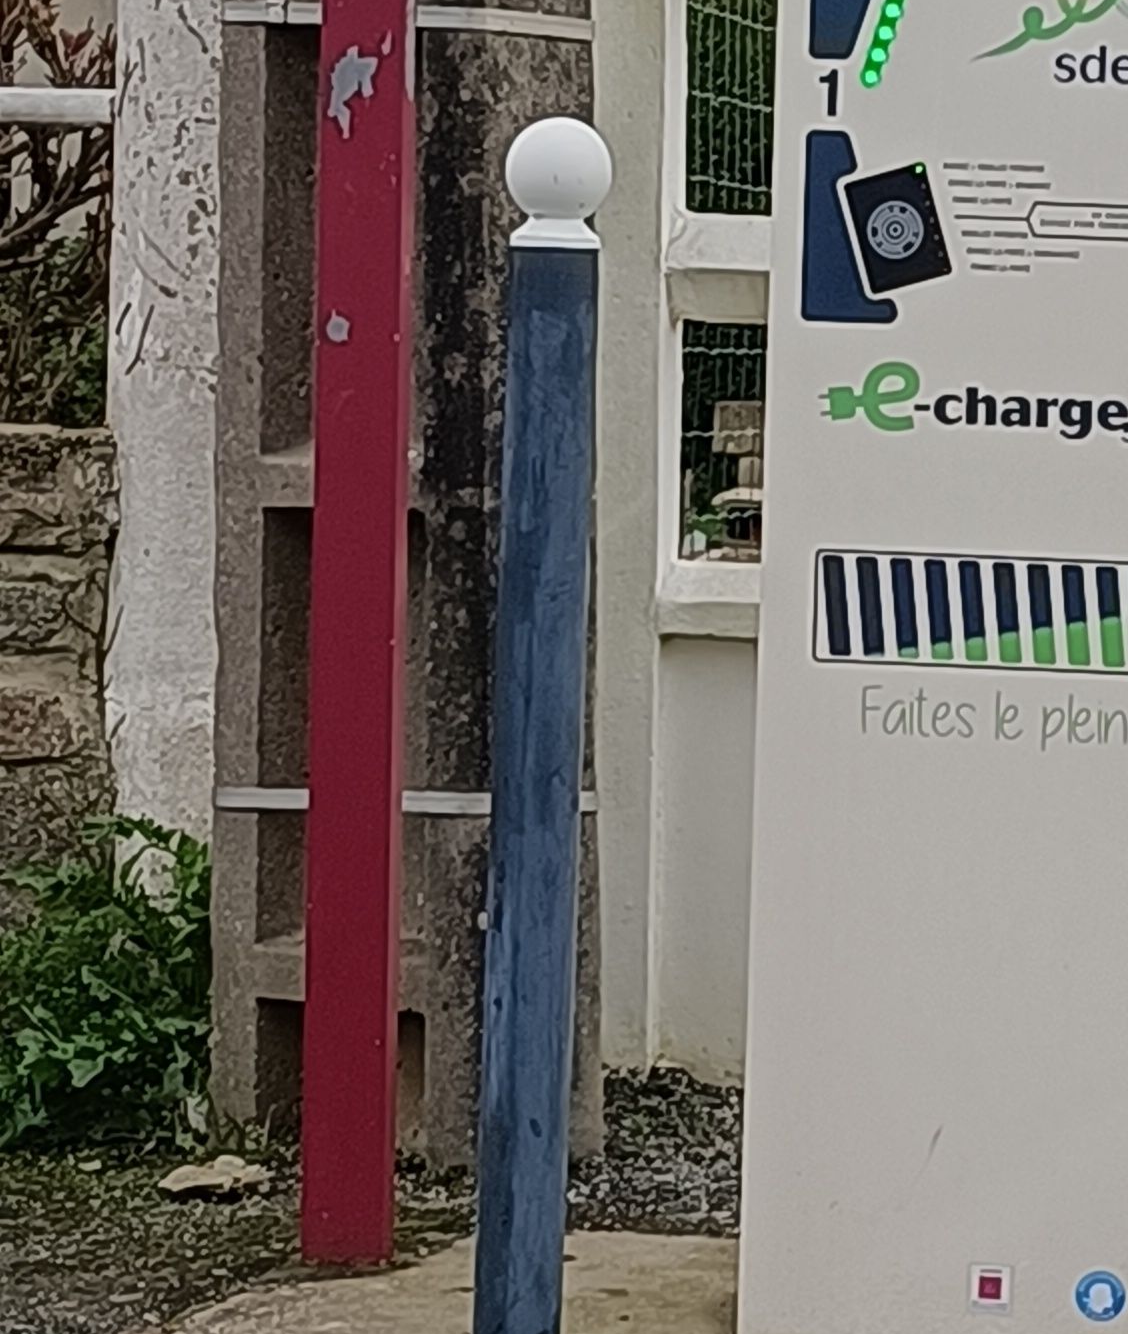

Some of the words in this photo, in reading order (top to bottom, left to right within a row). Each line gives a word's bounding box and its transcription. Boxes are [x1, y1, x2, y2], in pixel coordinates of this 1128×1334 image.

[819, 68, 839, 117] 1
[860, 684, 976, 742] Faites
[995, 690, 1024, 741] le
[1041, 694, 1128, 752] plein
